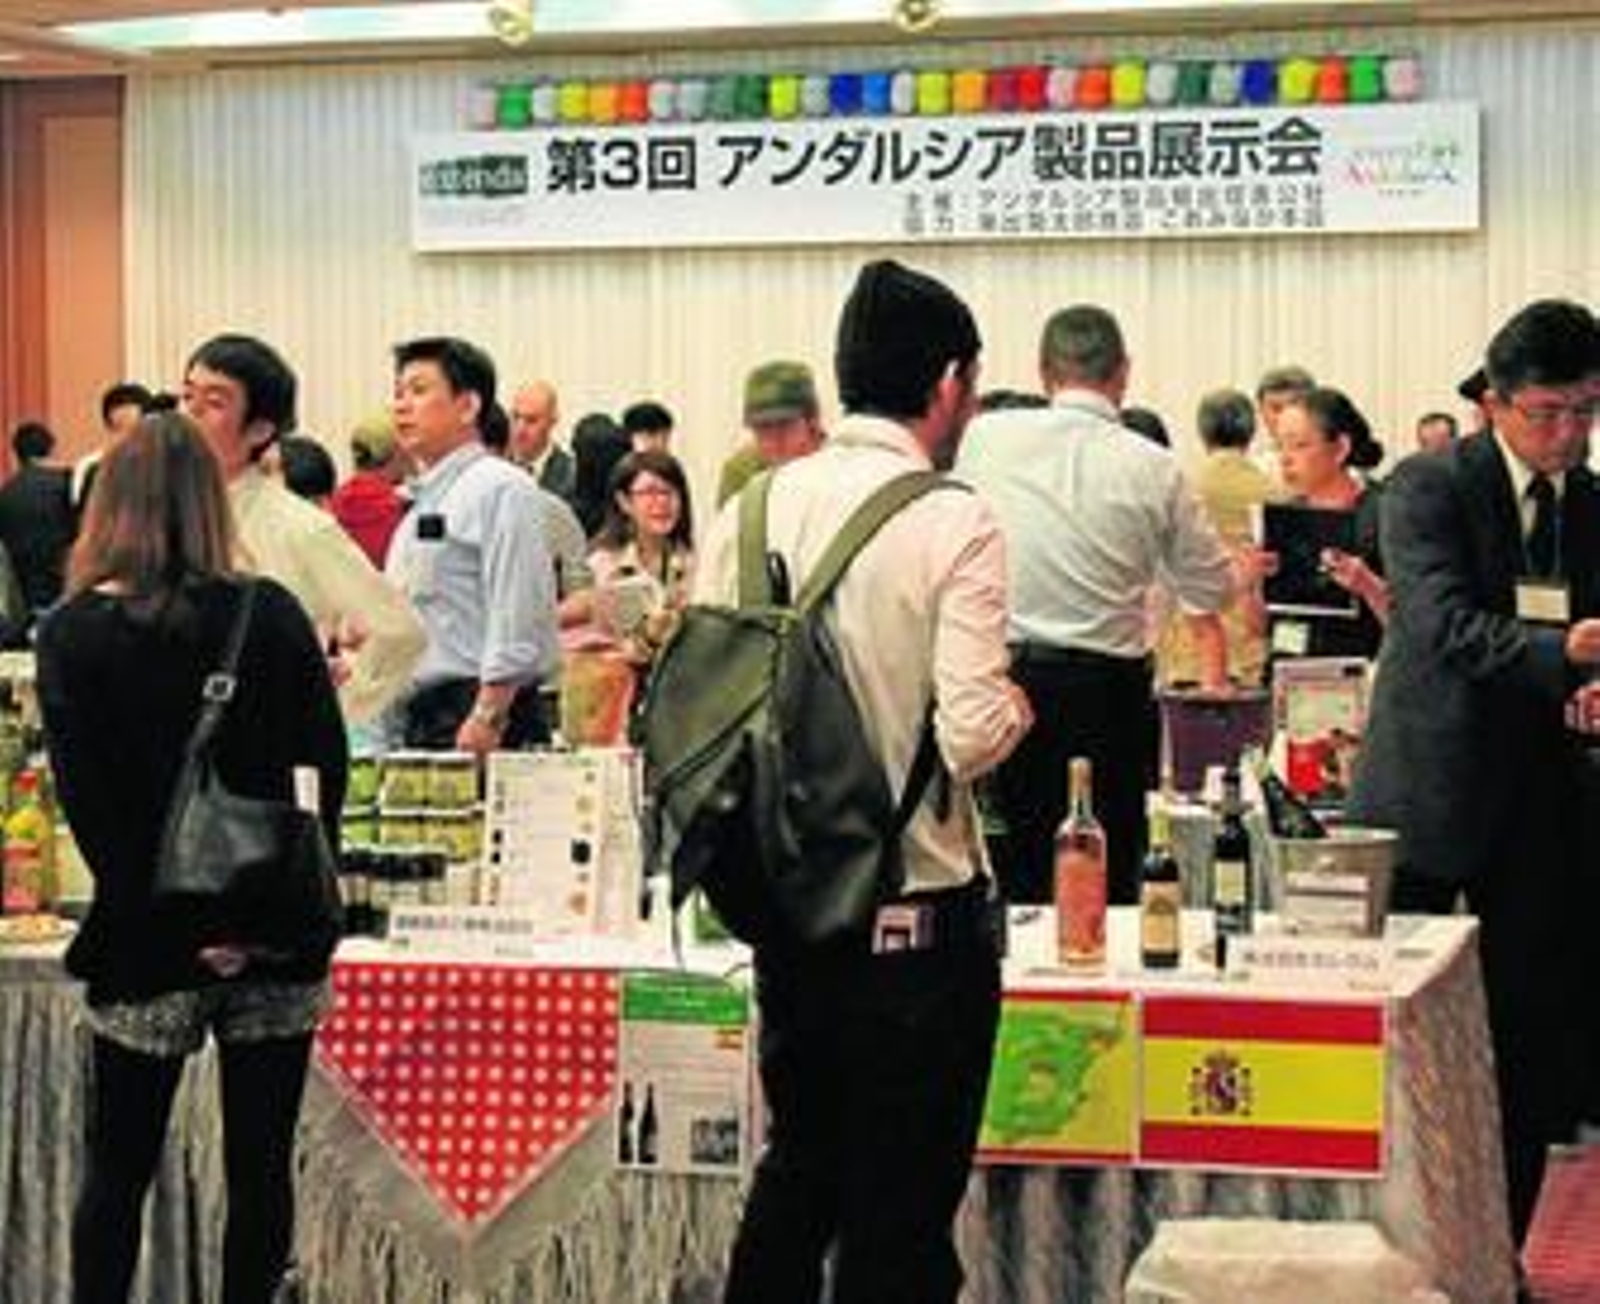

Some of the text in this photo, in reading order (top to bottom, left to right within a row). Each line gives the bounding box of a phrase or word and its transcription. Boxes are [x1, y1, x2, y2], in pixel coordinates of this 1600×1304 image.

[546, 136, 698, 194] 第3回
[715, 117, 1325, 188] アンダルシア製品展示会
